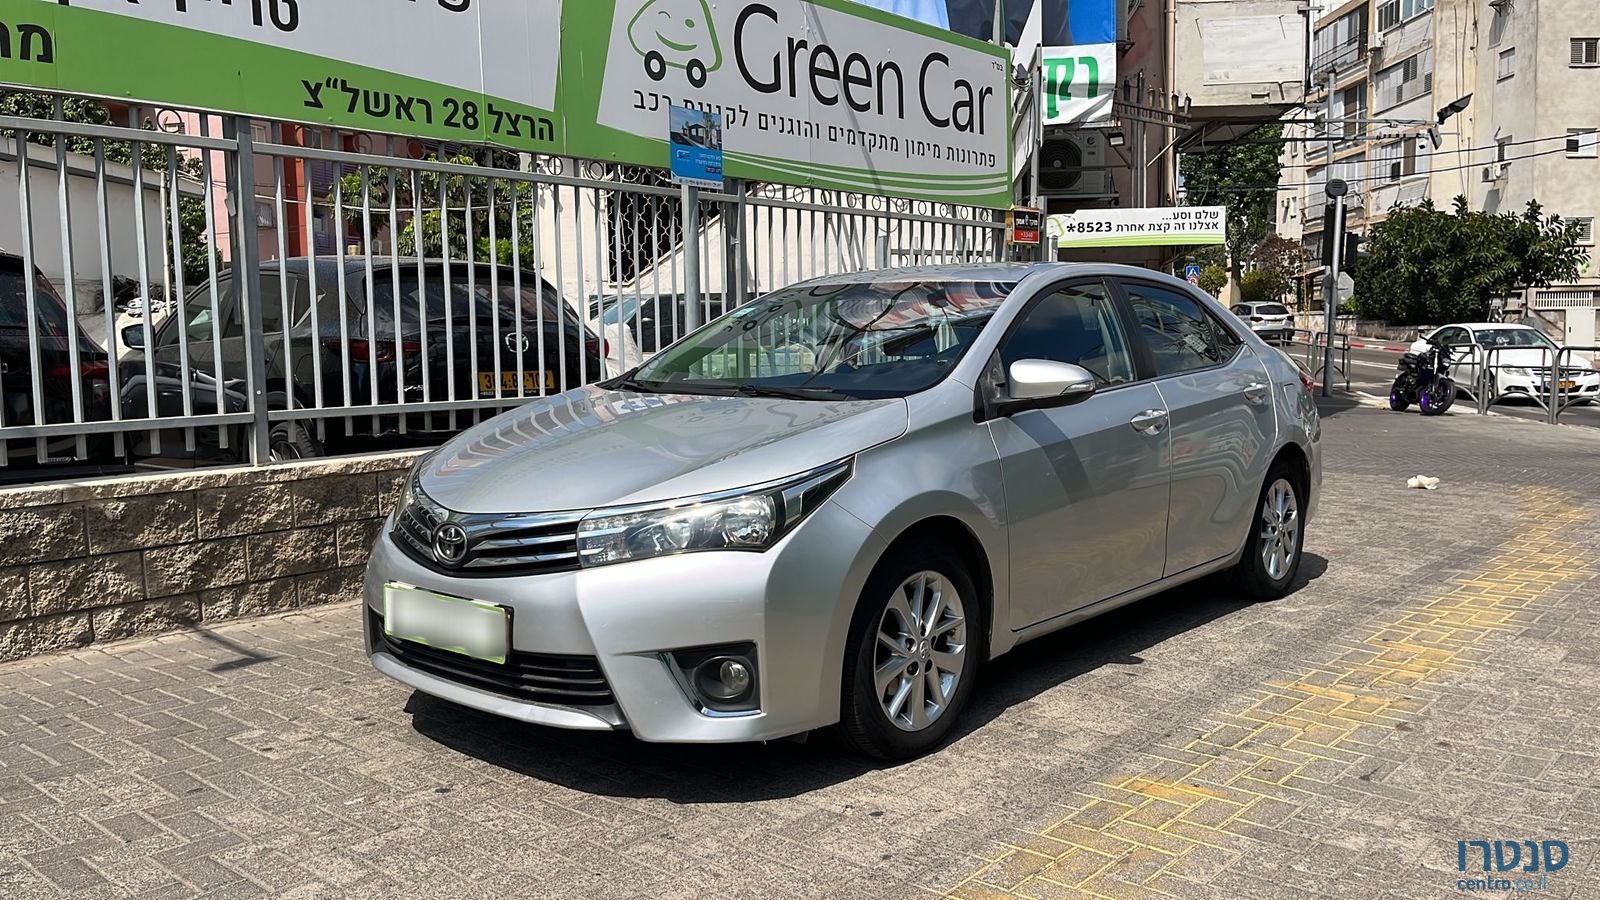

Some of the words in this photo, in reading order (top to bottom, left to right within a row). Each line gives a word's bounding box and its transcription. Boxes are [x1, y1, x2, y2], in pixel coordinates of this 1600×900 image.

[733, 3, 904, 120] Green
[919, 52, 992, 135] Car
[633, 89, 672, 112] רכב
[442, 97, 479, 131] 28
[488, 103, 554, 142] הרצל
[758, 113, 820, 139] והוגנים
[828, 125, 899, 152] מתקדמים
[905, 138, 941, 159] מימון
[946, 146, 996, 168] פתרונות
[1161, 211, 1191, 221] וסע...
[1189, 221, 1219, 230] אצלנו
[1195, 210, 1219, 220] שלם
[1116, 223, 1145, 232] אחרת
[1148, 223, 1170, 233] קצת
[1174, 222, 1186, 231] זה
